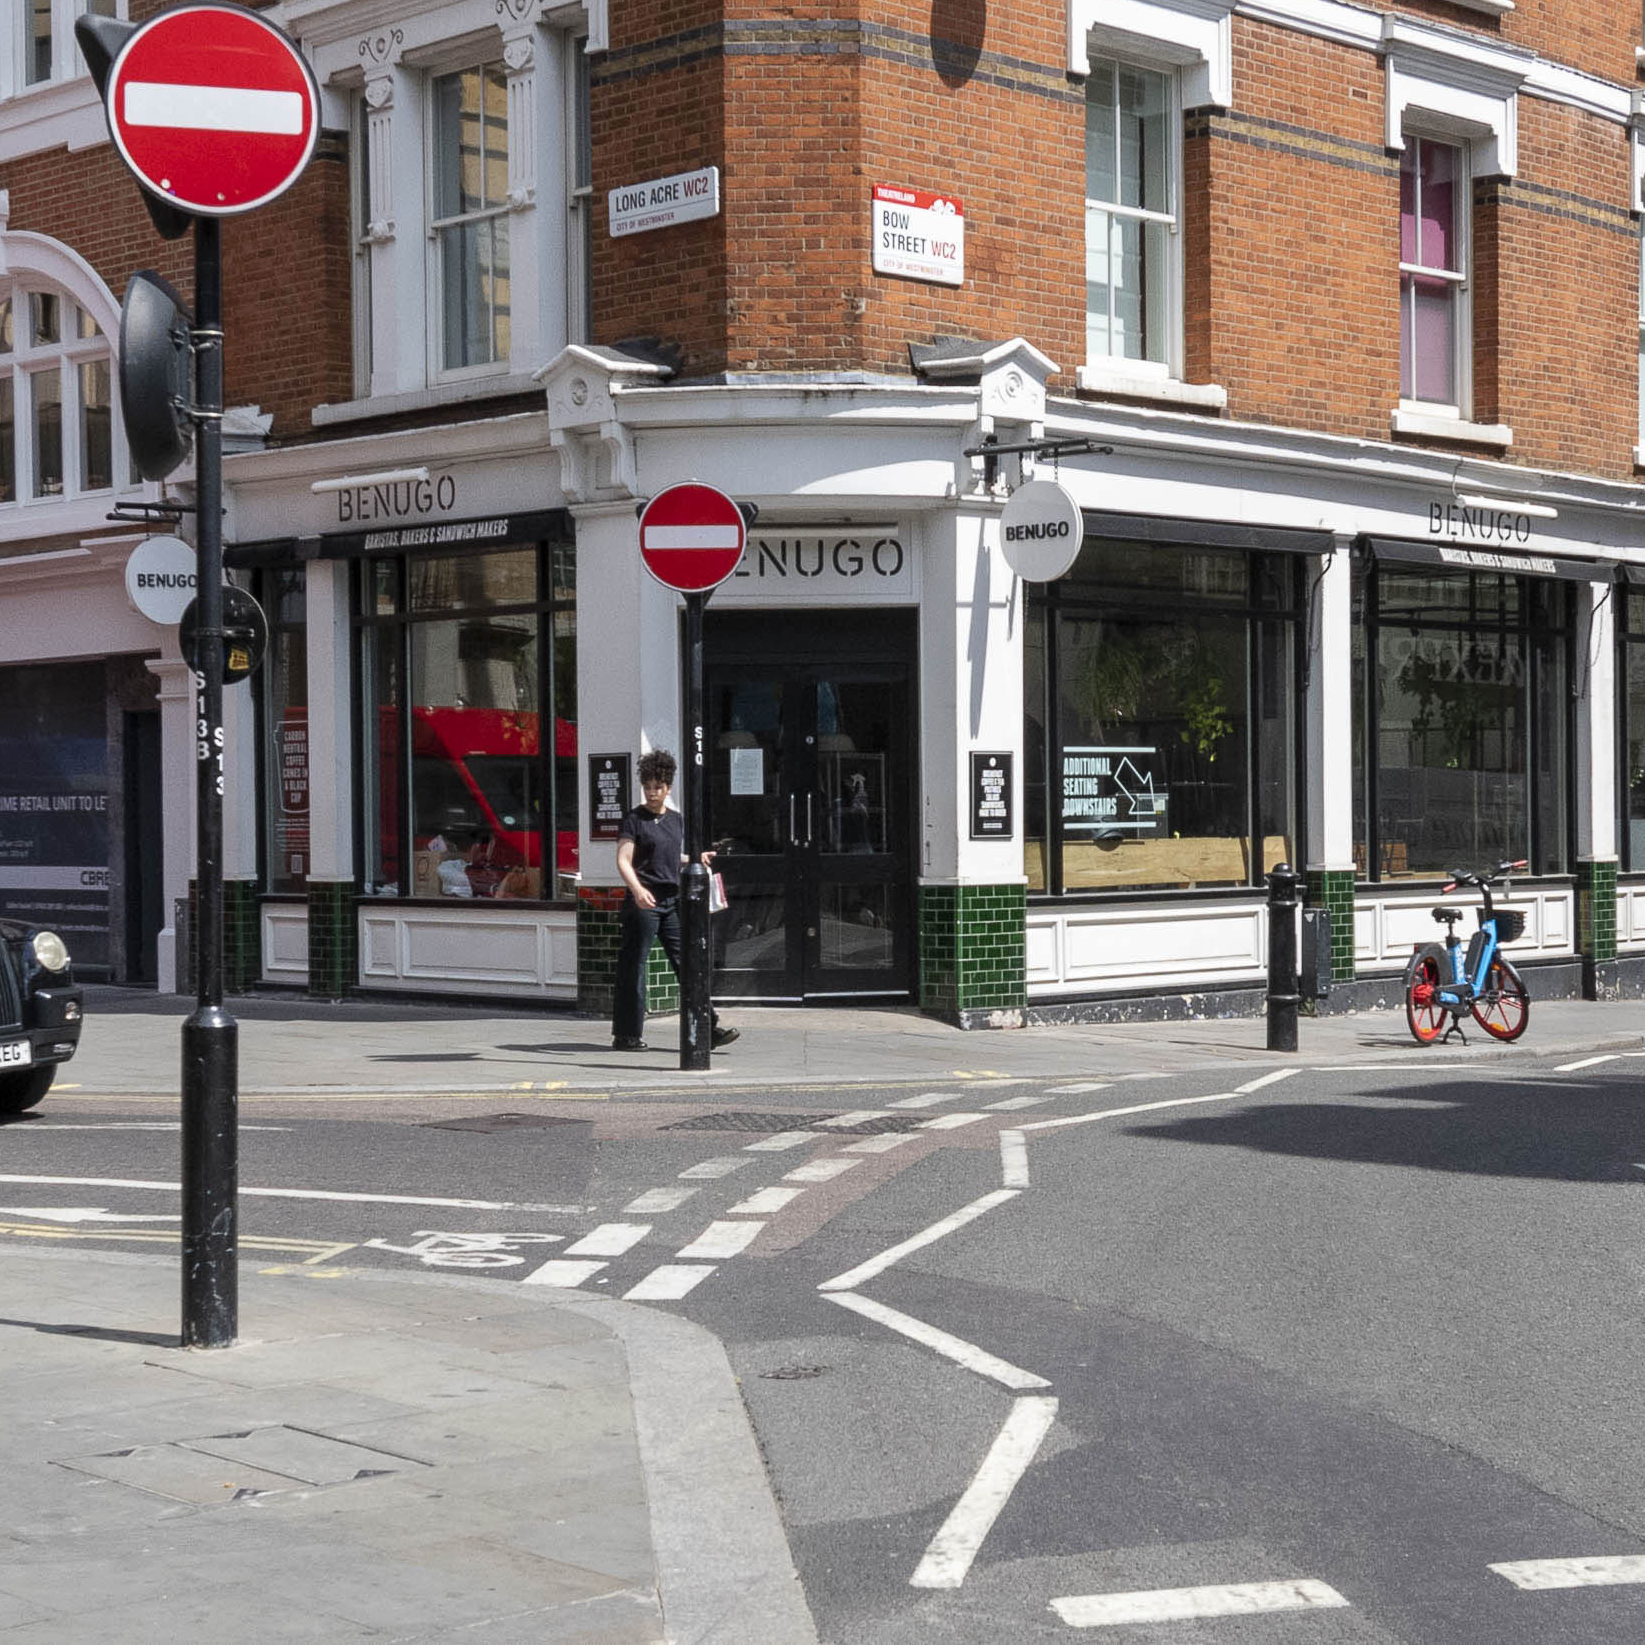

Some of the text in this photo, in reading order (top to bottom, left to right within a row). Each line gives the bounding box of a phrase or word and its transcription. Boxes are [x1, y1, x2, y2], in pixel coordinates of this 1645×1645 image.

[616, 176, 708, 213] LONG ACRE WC2
[637, 212, 675, 227] WESTMINSTER
[883, 210, 910, 230] BOW
[882, 231, 956, 260] STREET WC2
[338, 475, 455, 522] BENUGO
[436, 523, 476, 542] SANDWICH
[476, 519, 509, 538] MAKERS
[1006, 521, 1070, 542] BENUGO
[1430, 502, 1530, 543] BENUGO
[735, 539, 904, 577] NUGO
[1064, 757, 1112, 776] ADDITIONAL
[1063, 777, 1098, 796] SEATING
[20, 796, 52, 811] RETAIL
[53, 796, 76, 811] UNIT
[78, 795, 93, 811] TO
[94, 795, 107, 811] LE
[1063, 798, 1117, 817] DOWNSTAIRS
[80, 870, 112, 886] CBRE
